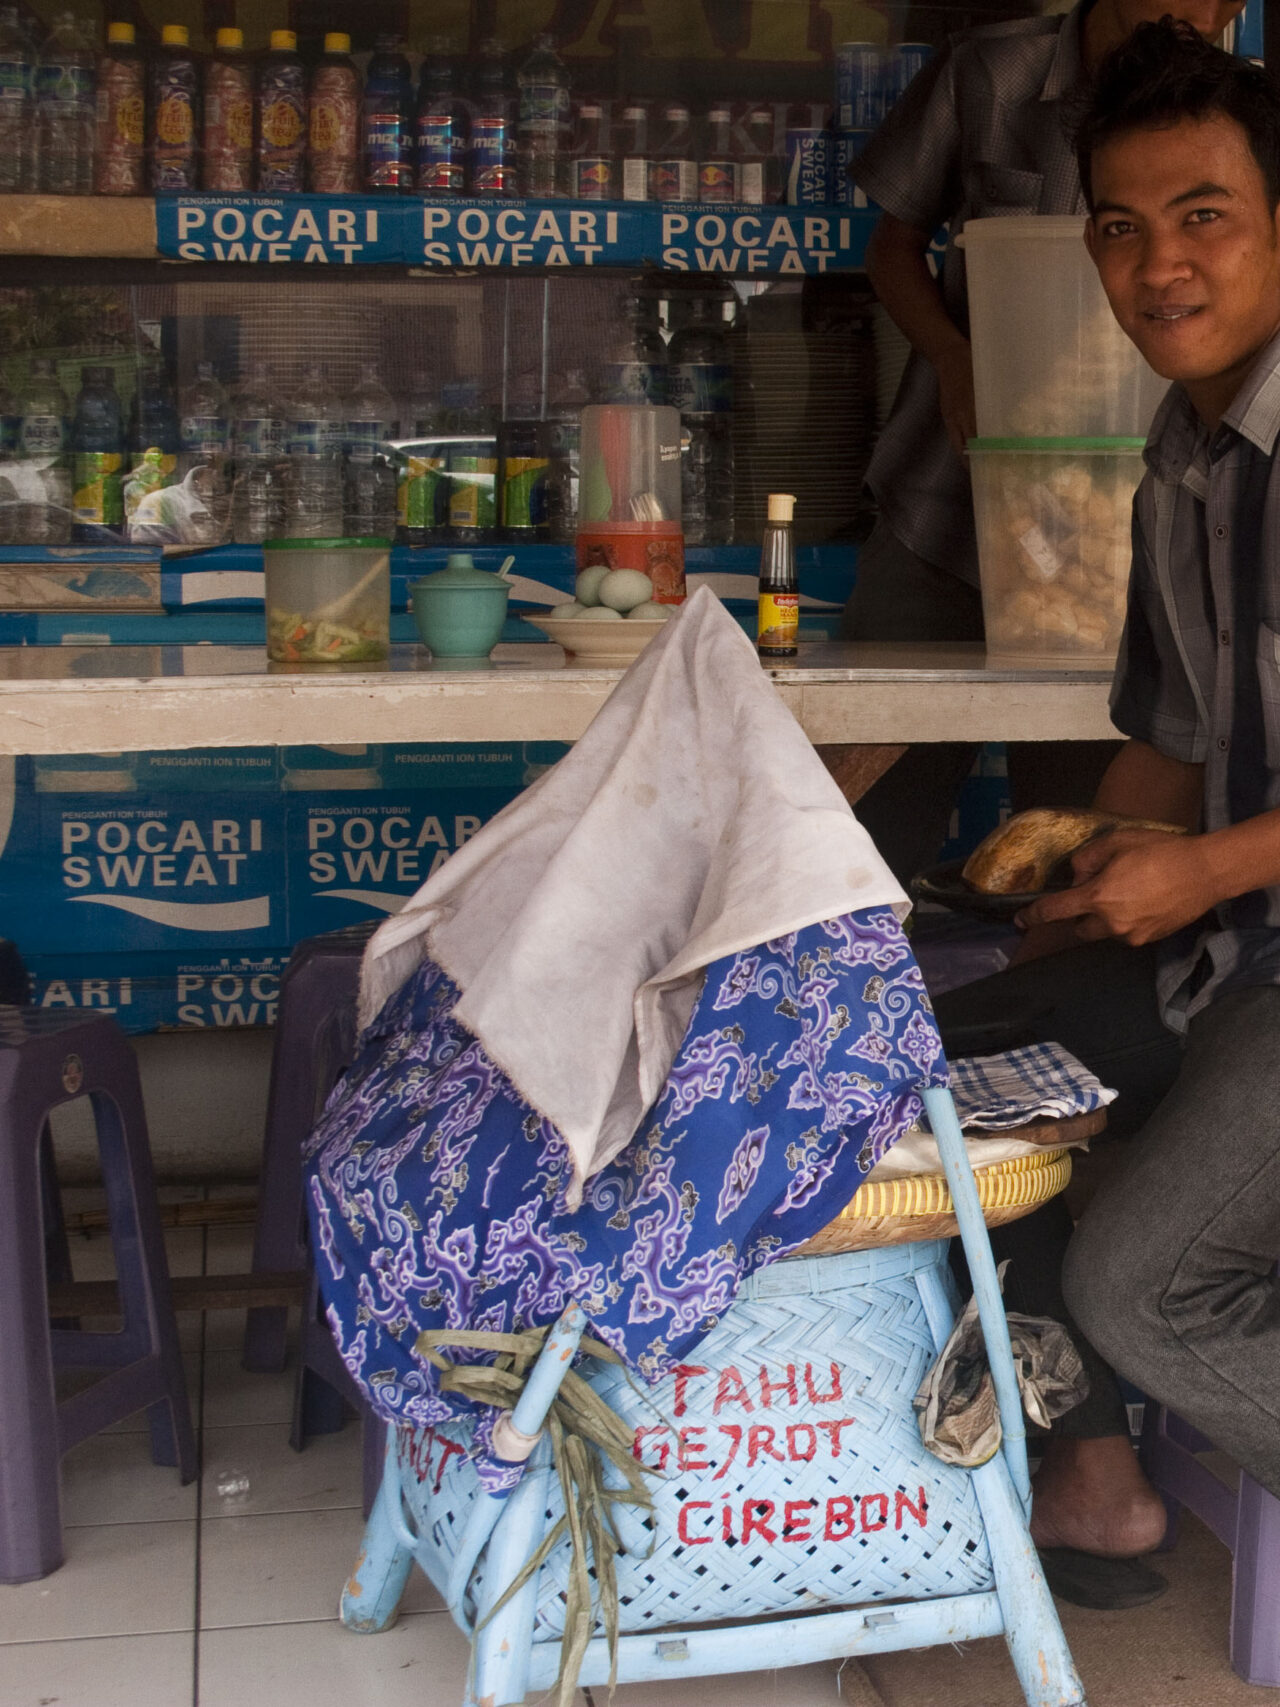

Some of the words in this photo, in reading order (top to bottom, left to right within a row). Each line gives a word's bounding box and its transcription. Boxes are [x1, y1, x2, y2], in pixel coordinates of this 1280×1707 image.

[177, 207, 379, 242] POCARI
[424, 207, 618, 243] POCARI
[662, 212, 851, 250] POCARI
[178, 242, 364, 264] SWEAT
[424, 242, 603, 267] SWEAT
[662, 246, 837, 273] SWEAT
[149, 757, 211, 767] PENGGANTI
[213, 757, 233, 767] ION
[235, 757, 272, 767] TUBUH
[456, 754, 475, 763] ION
[477, 753, 513, 763] TUBUH
[362, 807, 378, 815] ION
[62, 818, 262, 854] POCARI
[62, 853, 247, 888] SWEAT
[671, 1363, 845, 1417] TAHU
